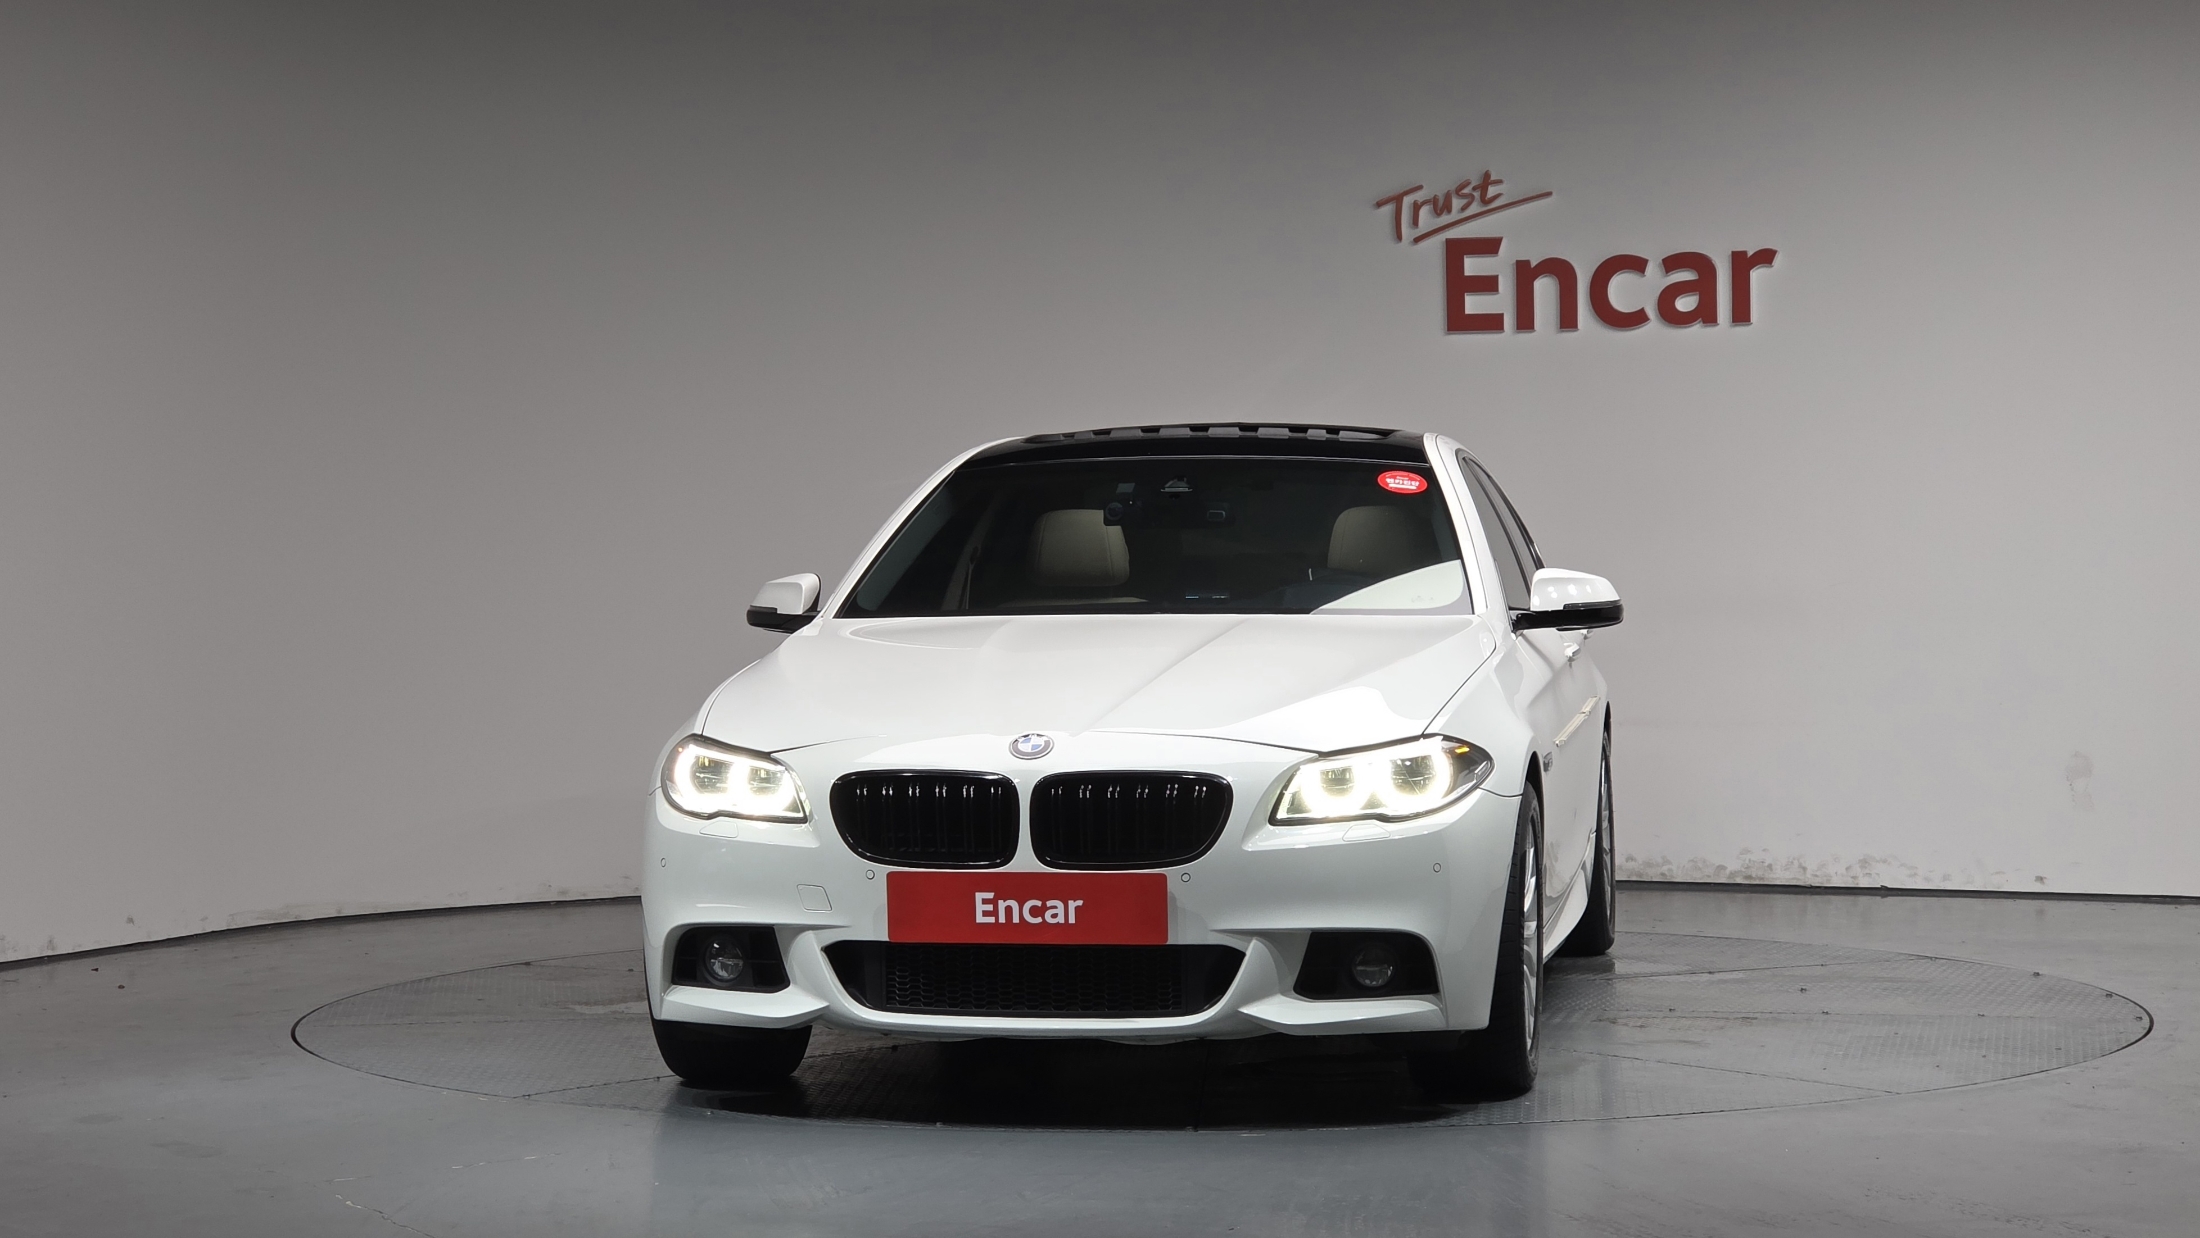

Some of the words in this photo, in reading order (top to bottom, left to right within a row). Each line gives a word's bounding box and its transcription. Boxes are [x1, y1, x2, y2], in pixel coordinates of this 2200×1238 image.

[1376, 169, 1504, 243] Trust
[1444, 236, 1779, 334] Encar
[974, 891, 1084, 924] Encar
